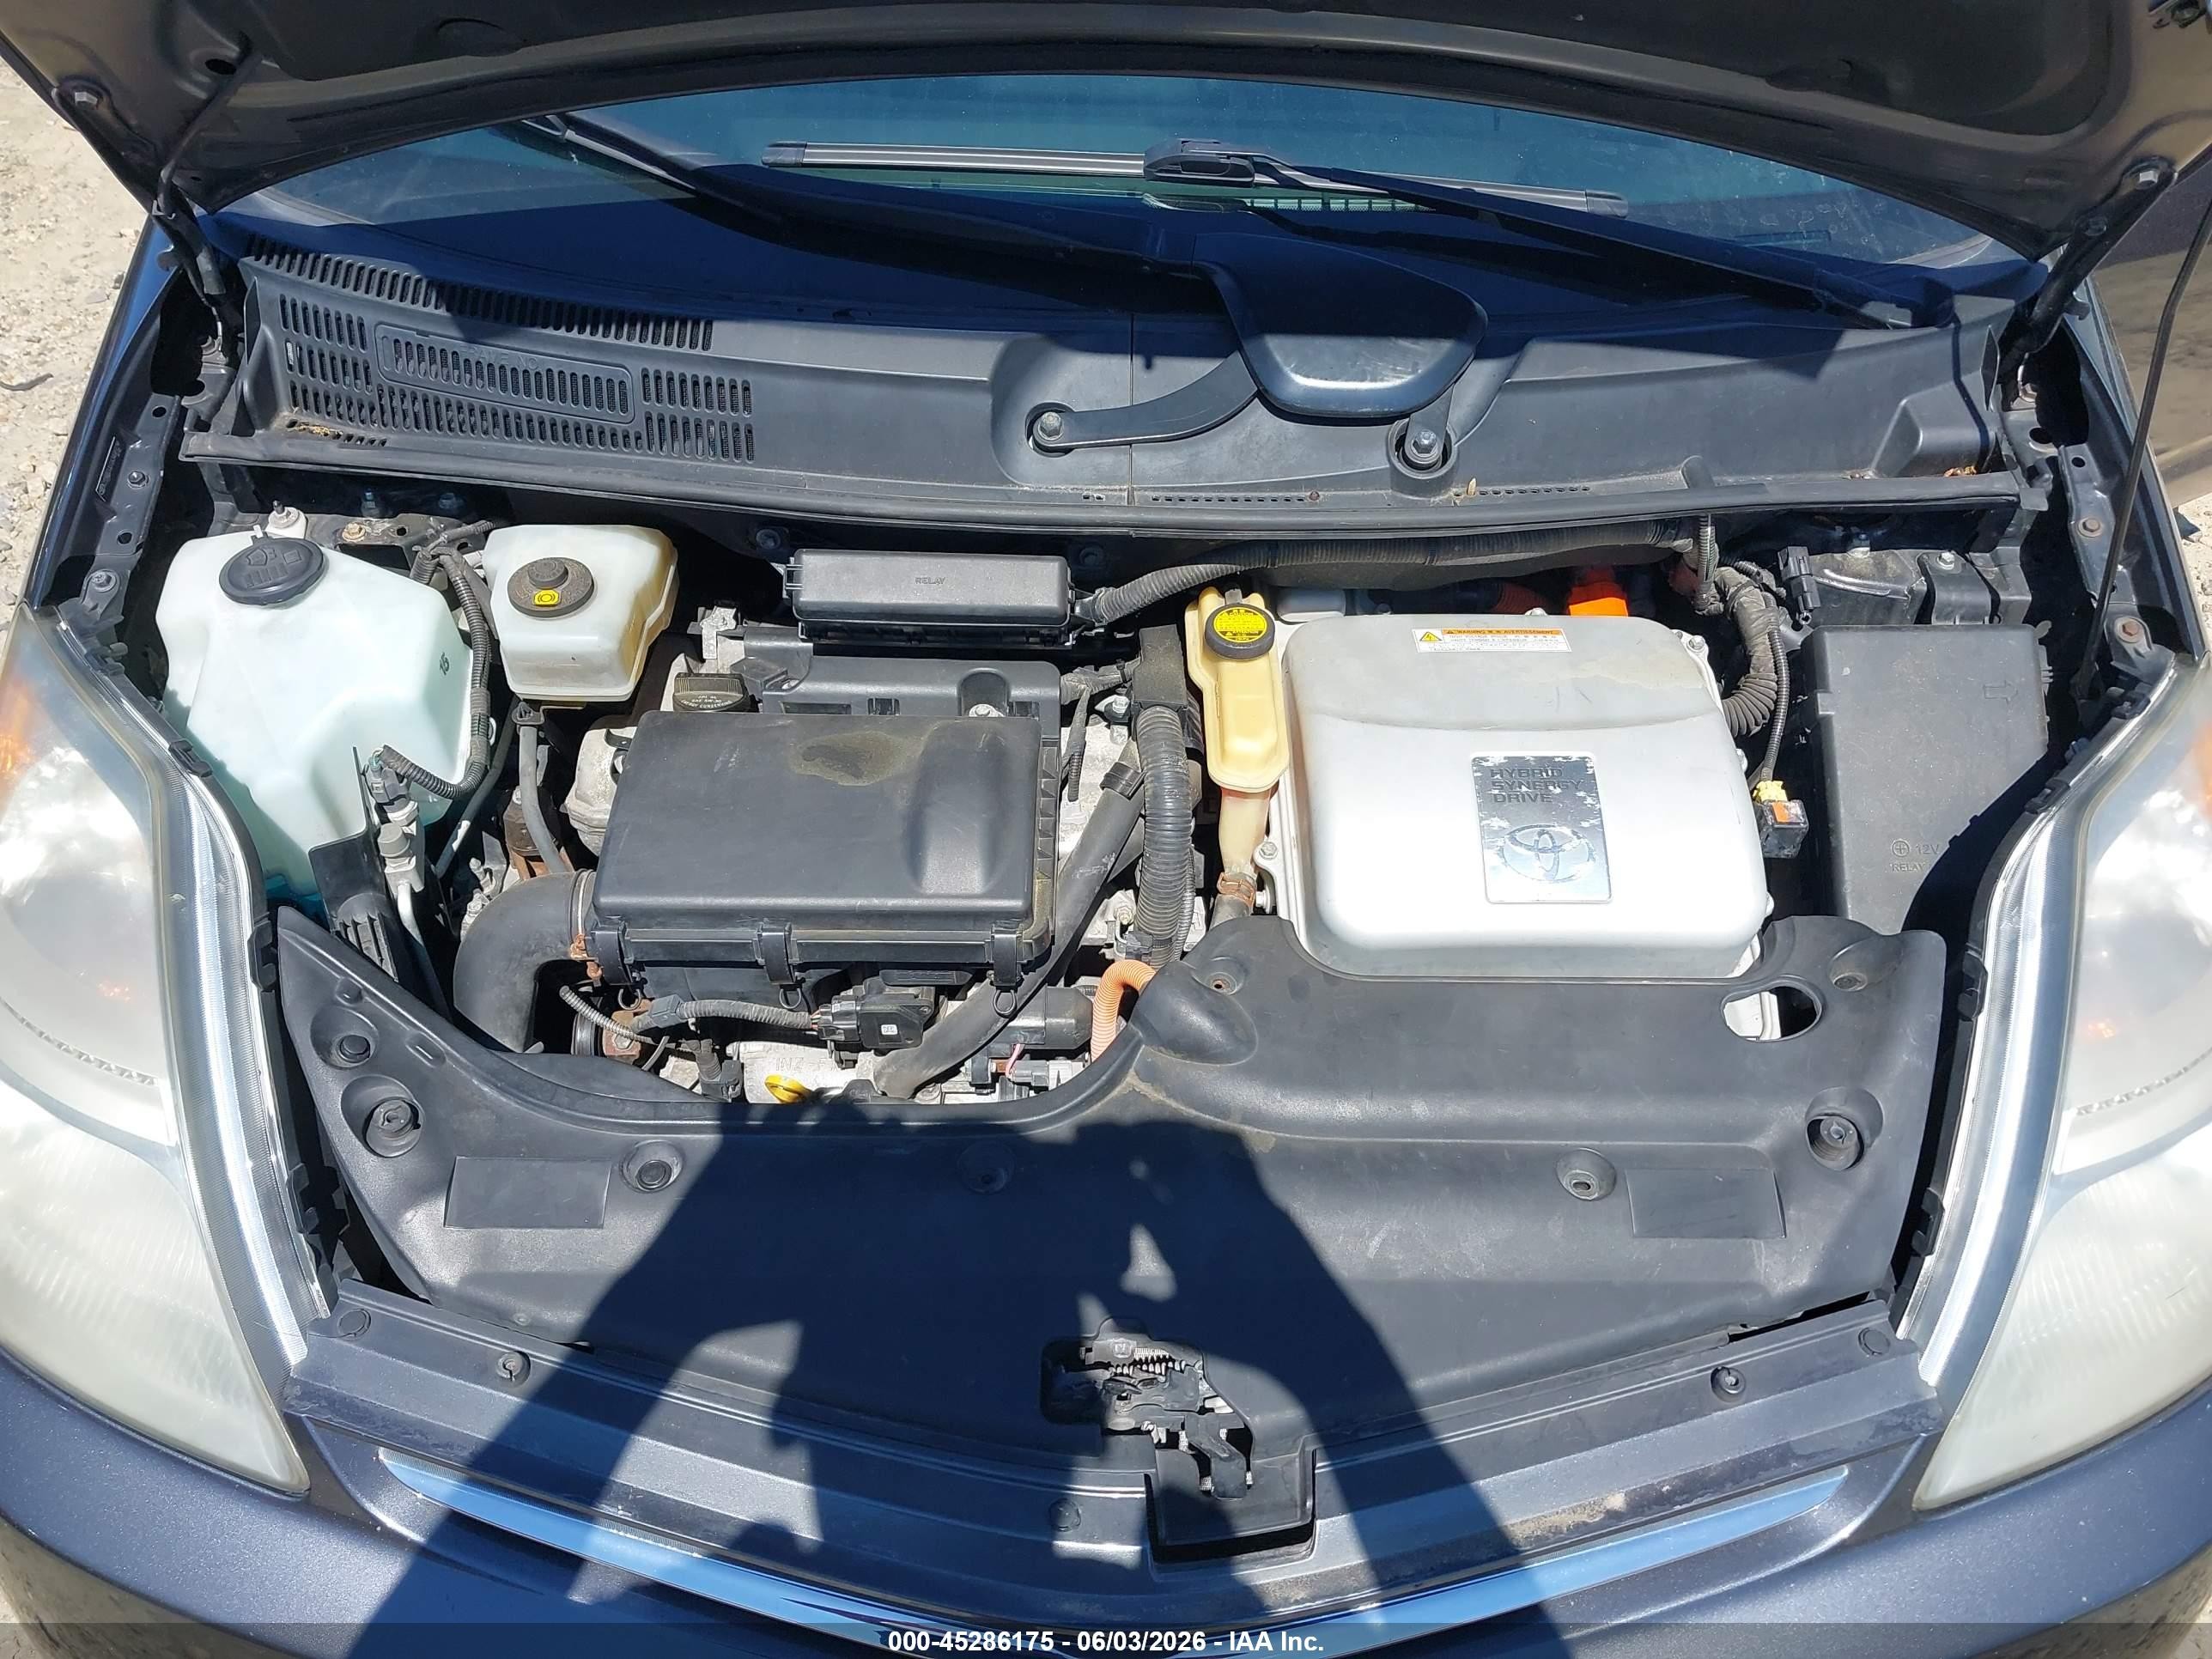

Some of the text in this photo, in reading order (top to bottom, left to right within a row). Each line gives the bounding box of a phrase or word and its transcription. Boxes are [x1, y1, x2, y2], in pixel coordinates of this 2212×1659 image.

[915, 576, 946, 585] RELAY
[1490, 768, 1563, 778] HYBRID
[1492, 780, 1583, 791] SYNERGY
[1492, 793, 1553, 803] DRIVE
[1916, 844, 1940, 855] 12V
[1891, 862, 1925, 872] RELAY
